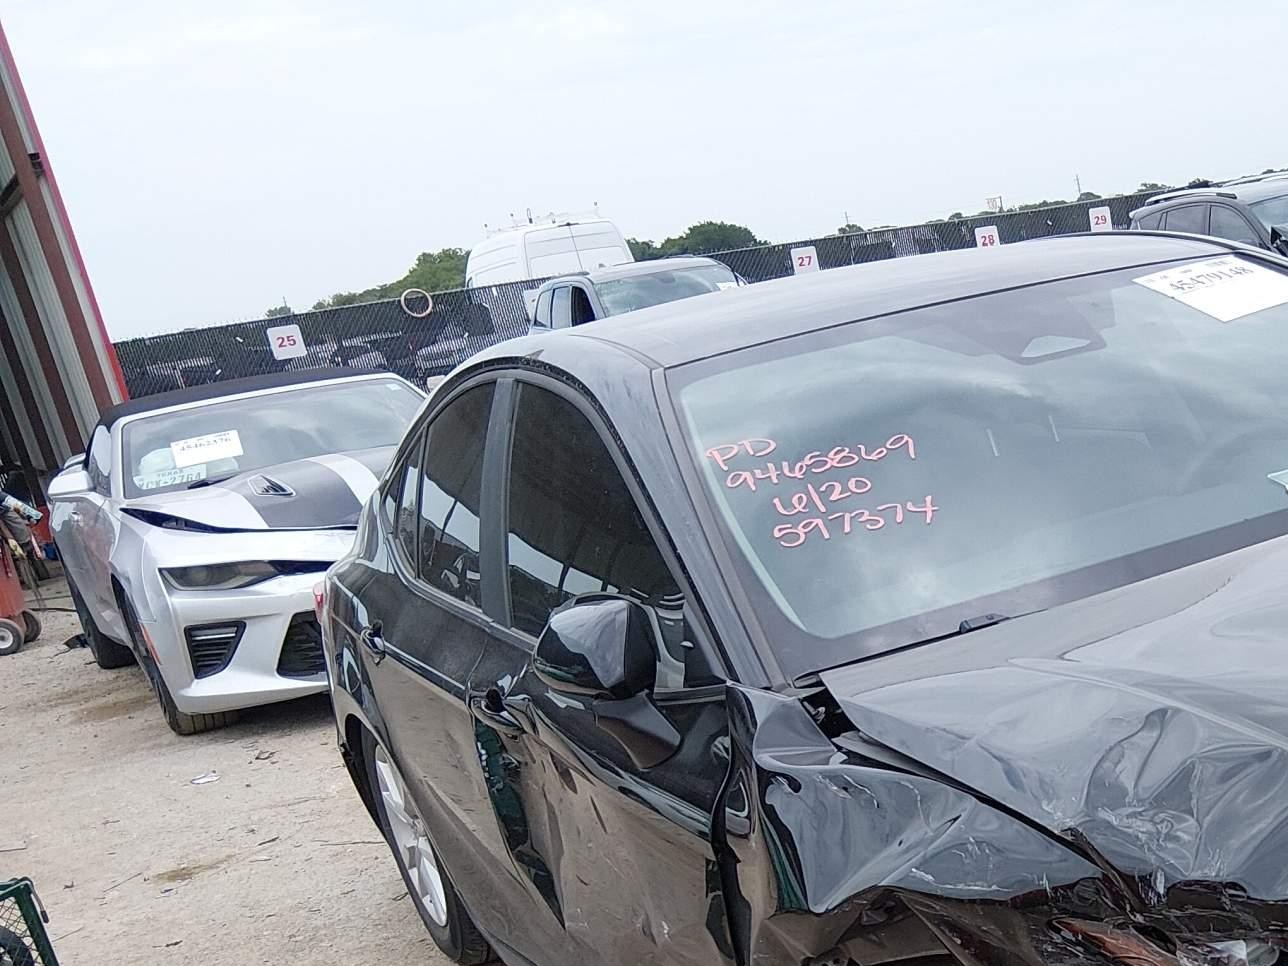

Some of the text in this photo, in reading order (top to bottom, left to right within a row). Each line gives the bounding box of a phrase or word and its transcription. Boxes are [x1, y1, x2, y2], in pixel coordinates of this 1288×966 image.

[1094, 214, 1107, 225] 29
[981, 234, 995, 246] 28
[797, 255, 812, 267] 27
[276, 335, 297, 348] 25
[706, 438, 777, 471] PD
[726, 433, 916, 491] 9465869
[773, 477, 872, 516] 6/20
[773, 495, 939, 547] 597374
